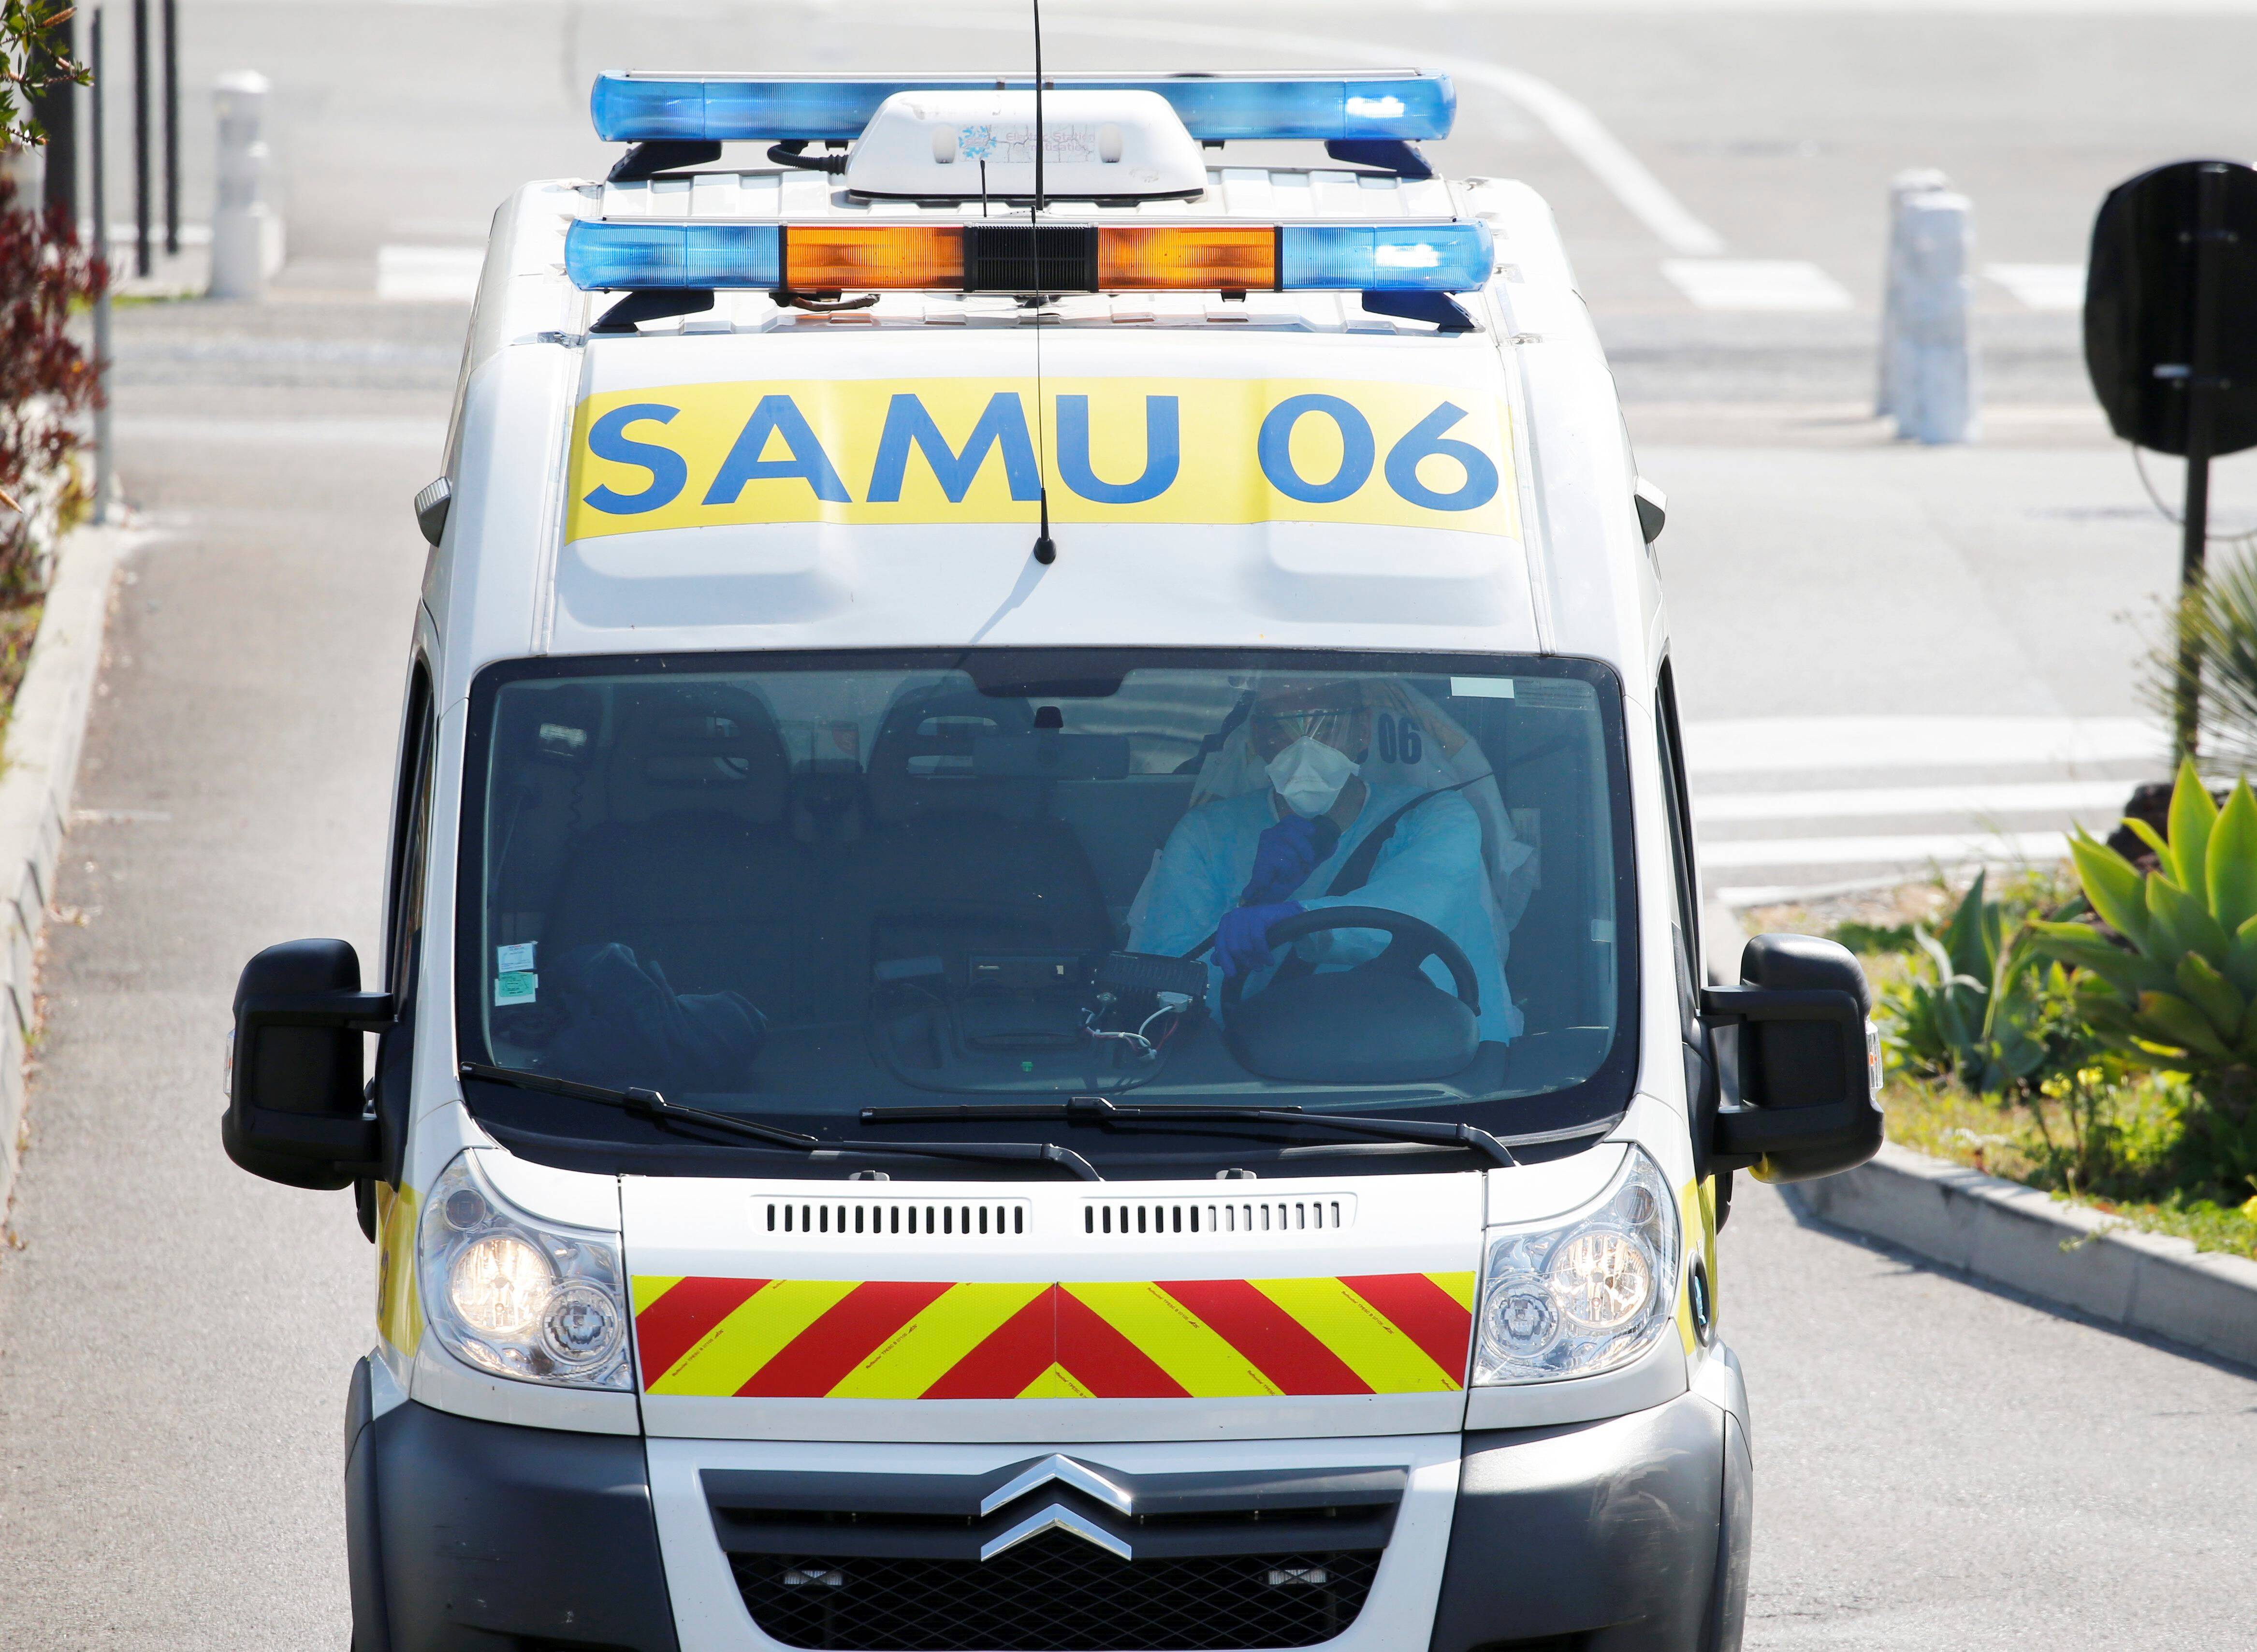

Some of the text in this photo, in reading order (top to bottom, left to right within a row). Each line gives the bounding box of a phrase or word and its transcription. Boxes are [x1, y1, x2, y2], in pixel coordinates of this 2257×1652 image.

[583, 392, 1499, 515] SAMU 06
[1378, 713, 1422, 765] 06
